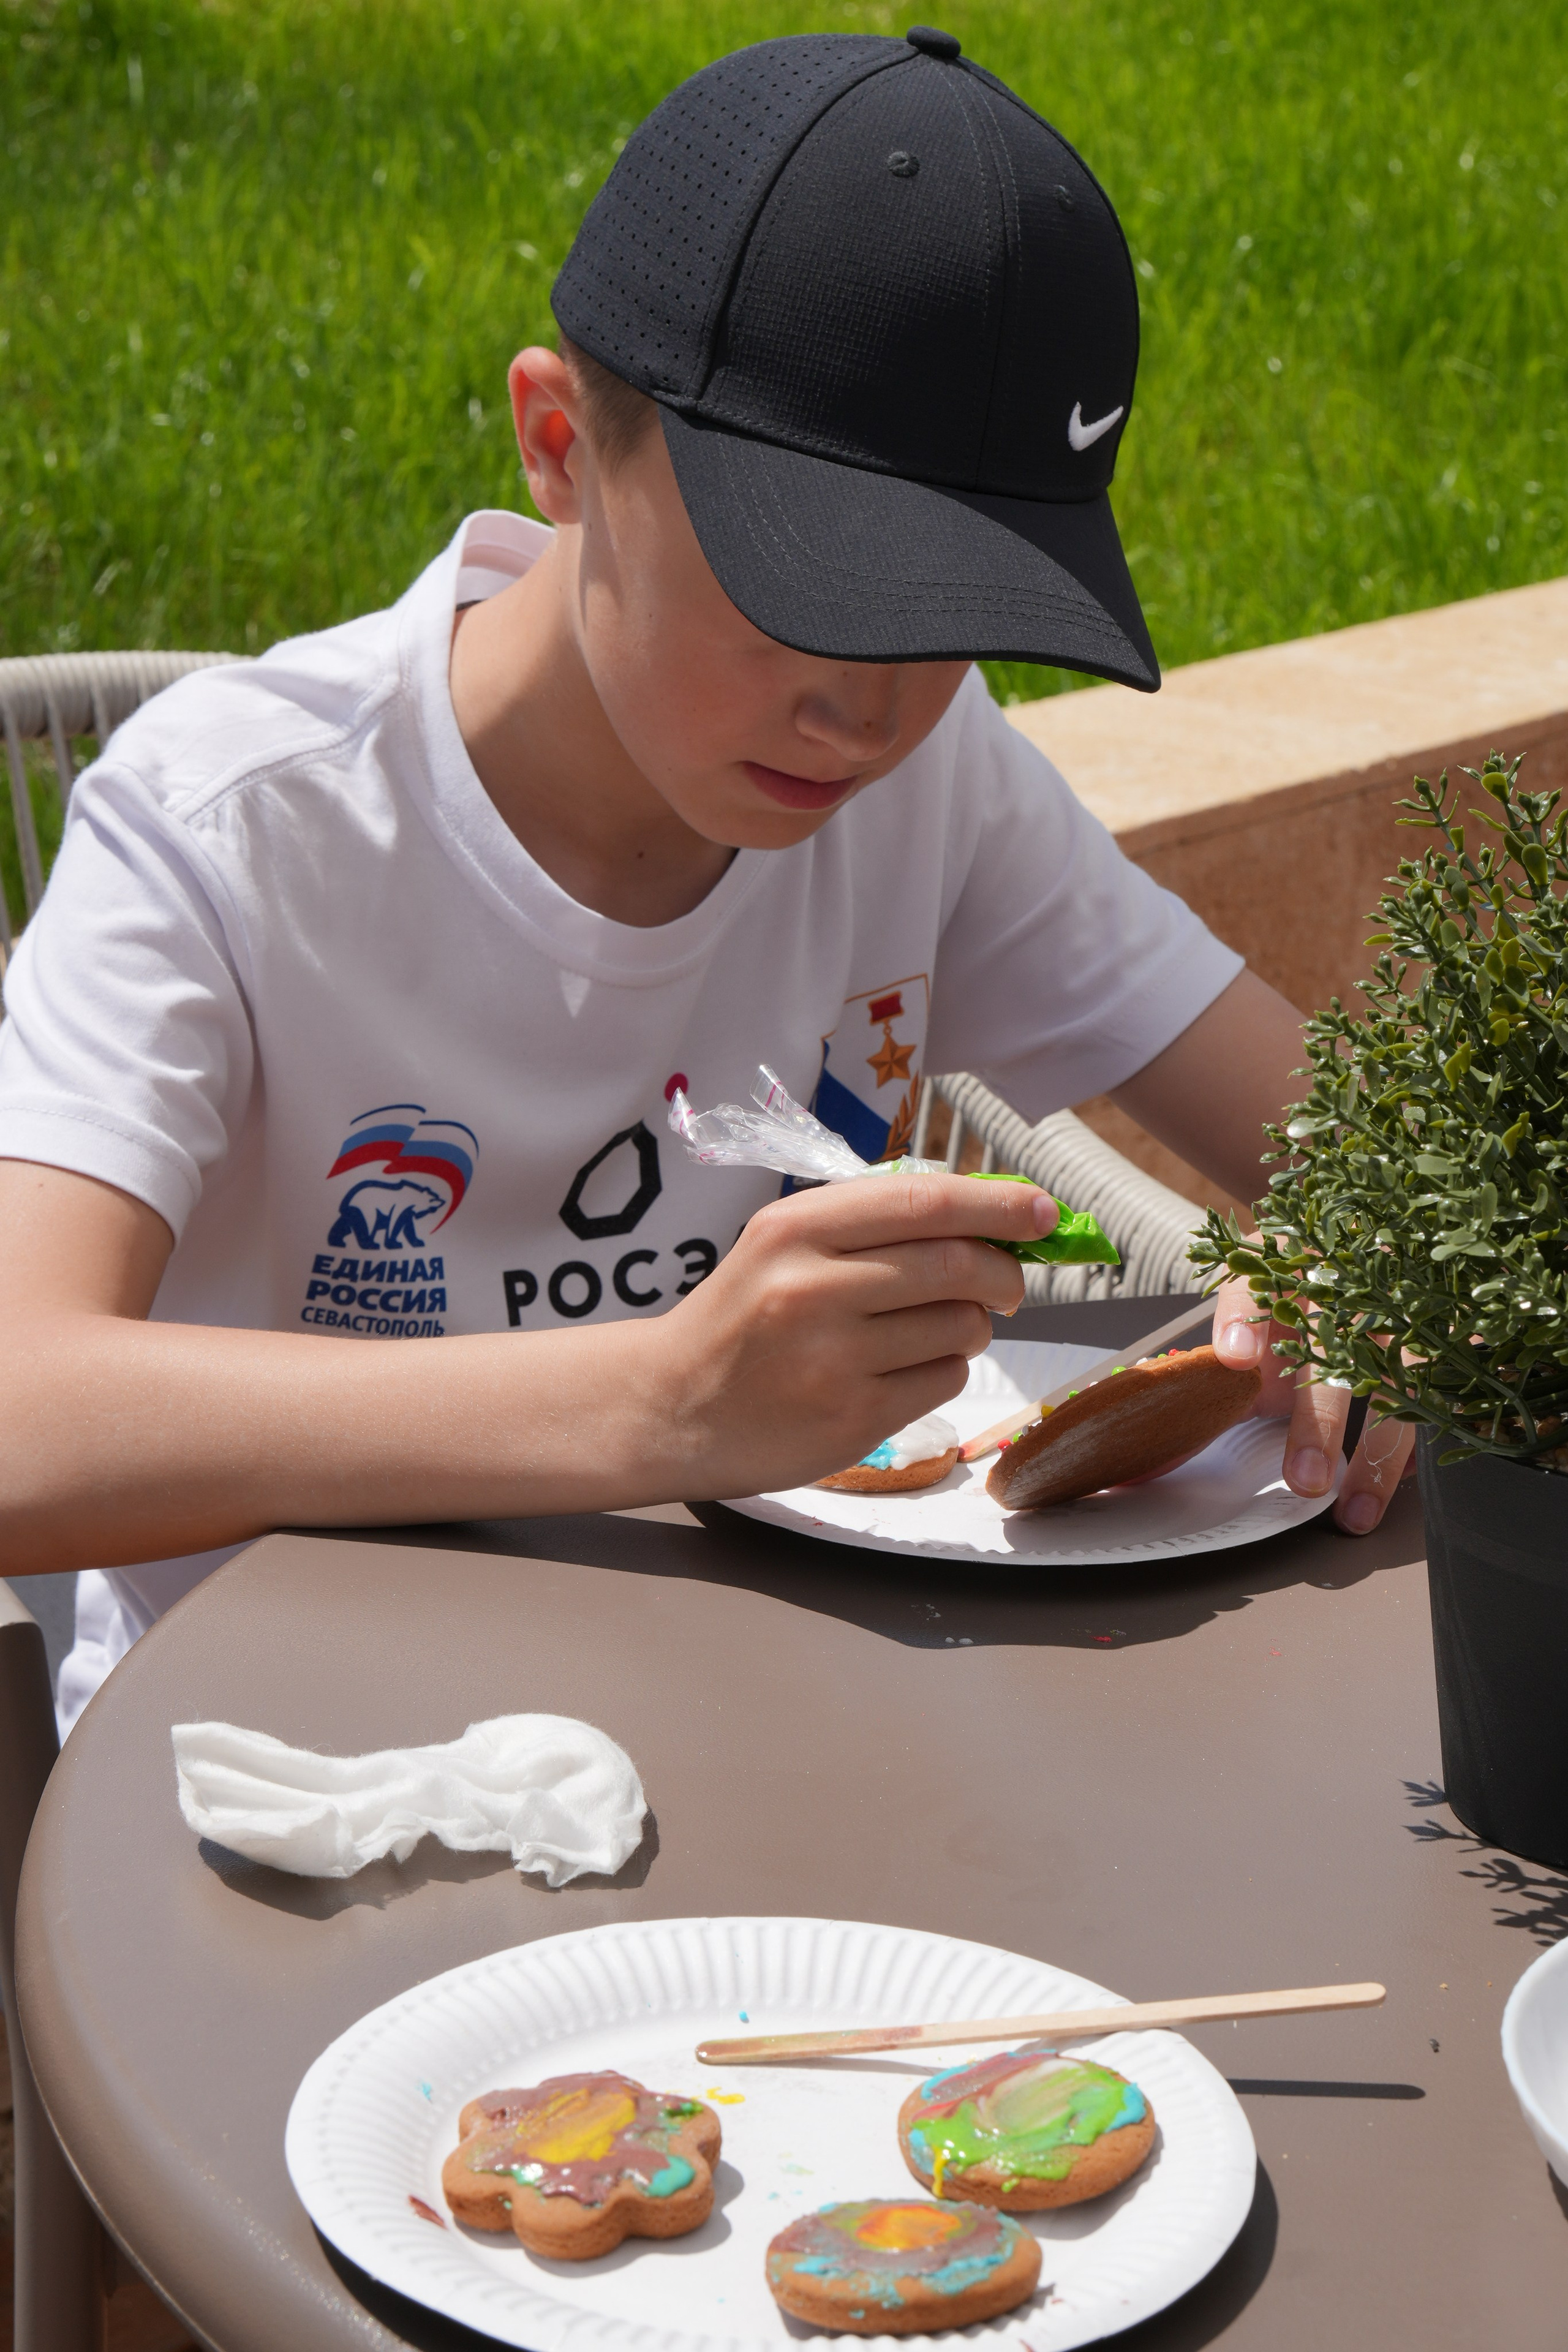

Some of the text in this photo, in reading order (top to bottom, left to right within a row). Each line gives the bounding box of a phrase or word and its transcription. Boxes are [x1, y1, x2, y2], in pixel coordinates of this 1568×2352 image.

[312, 1254, 445, 1283] ЕДИНАЯ
[503, 1224, 746, 1327] РОСЭ
[306, 1280, 447, 1314] РОССИЯ
[301, 1306, 446, 1338] СЕВАСТОПОЛЬ
